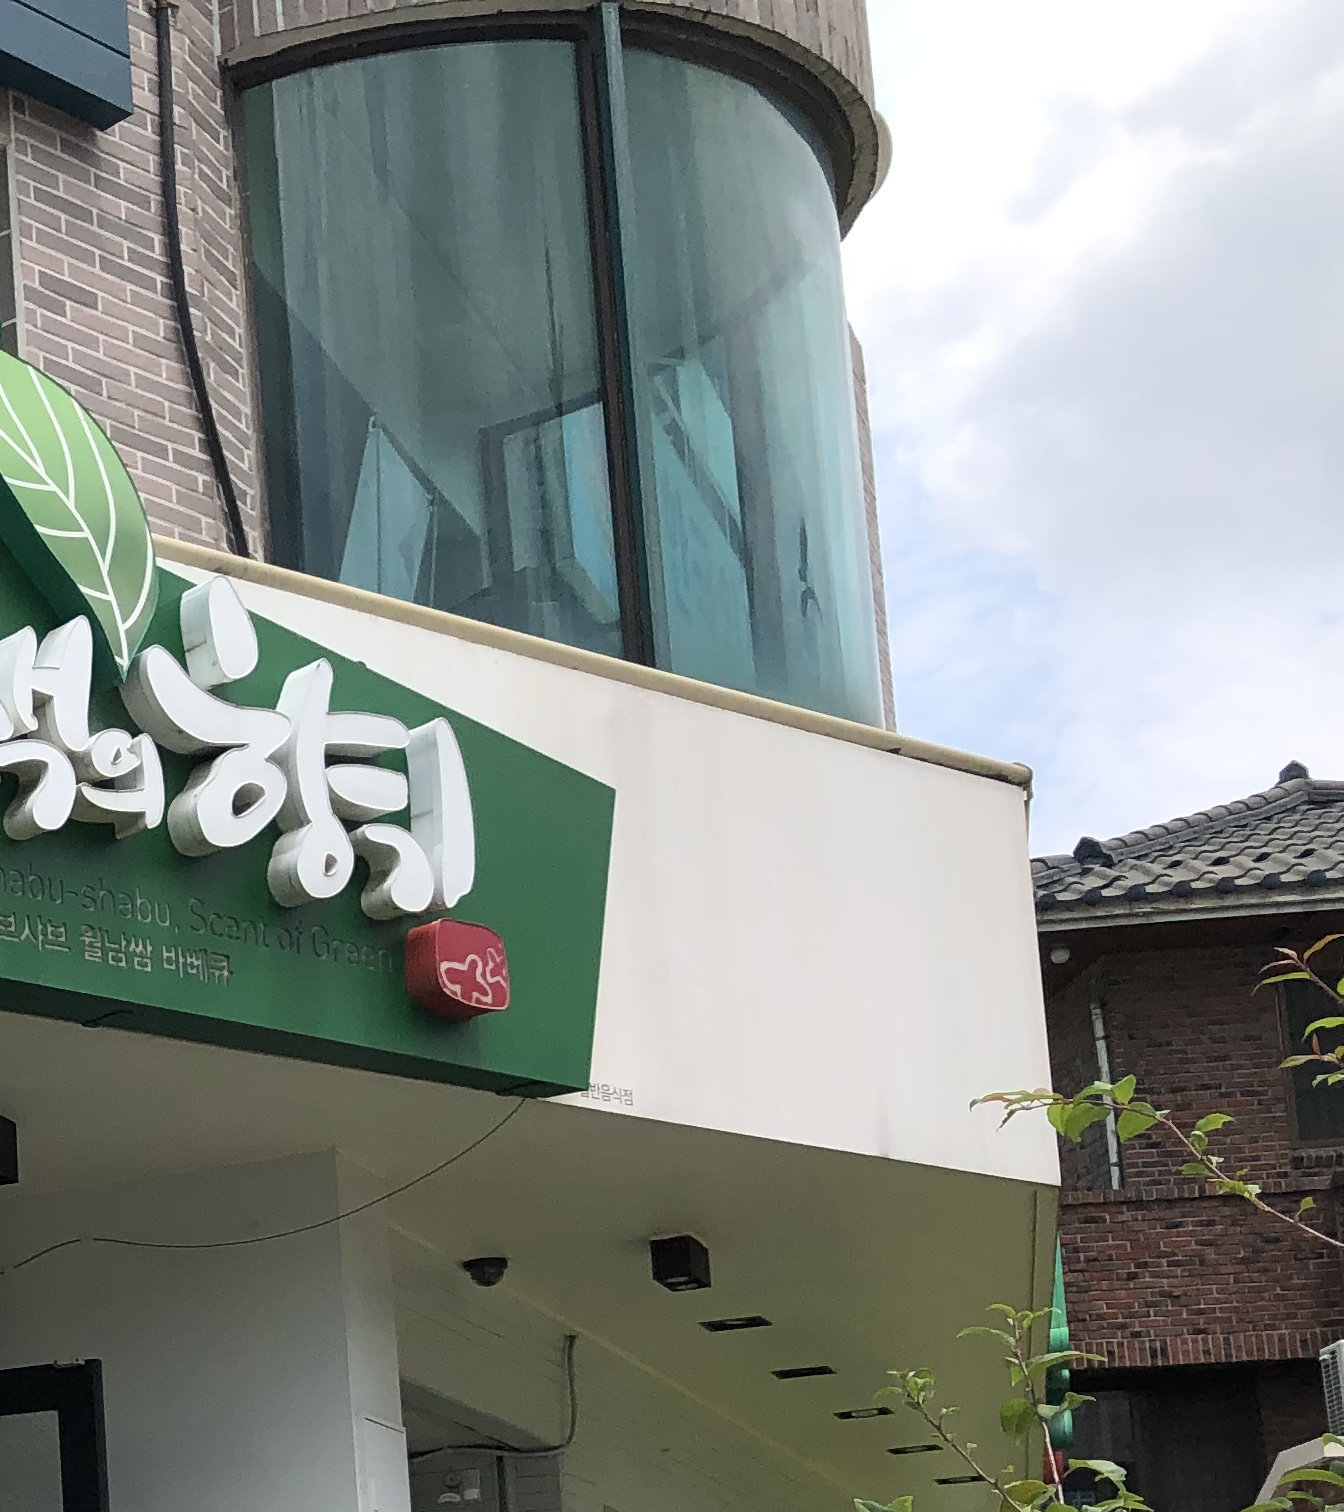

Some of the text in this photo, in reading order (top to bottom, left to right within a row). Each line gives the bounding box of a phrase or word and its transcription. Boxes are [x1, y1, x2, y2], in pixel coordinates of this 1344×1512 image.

[80, 923, 153, 973] 월남쌈
[188, 898, 269, 948] Scent
[276, 922, 303, 953] of
[311, 925, 394, 973] Green
